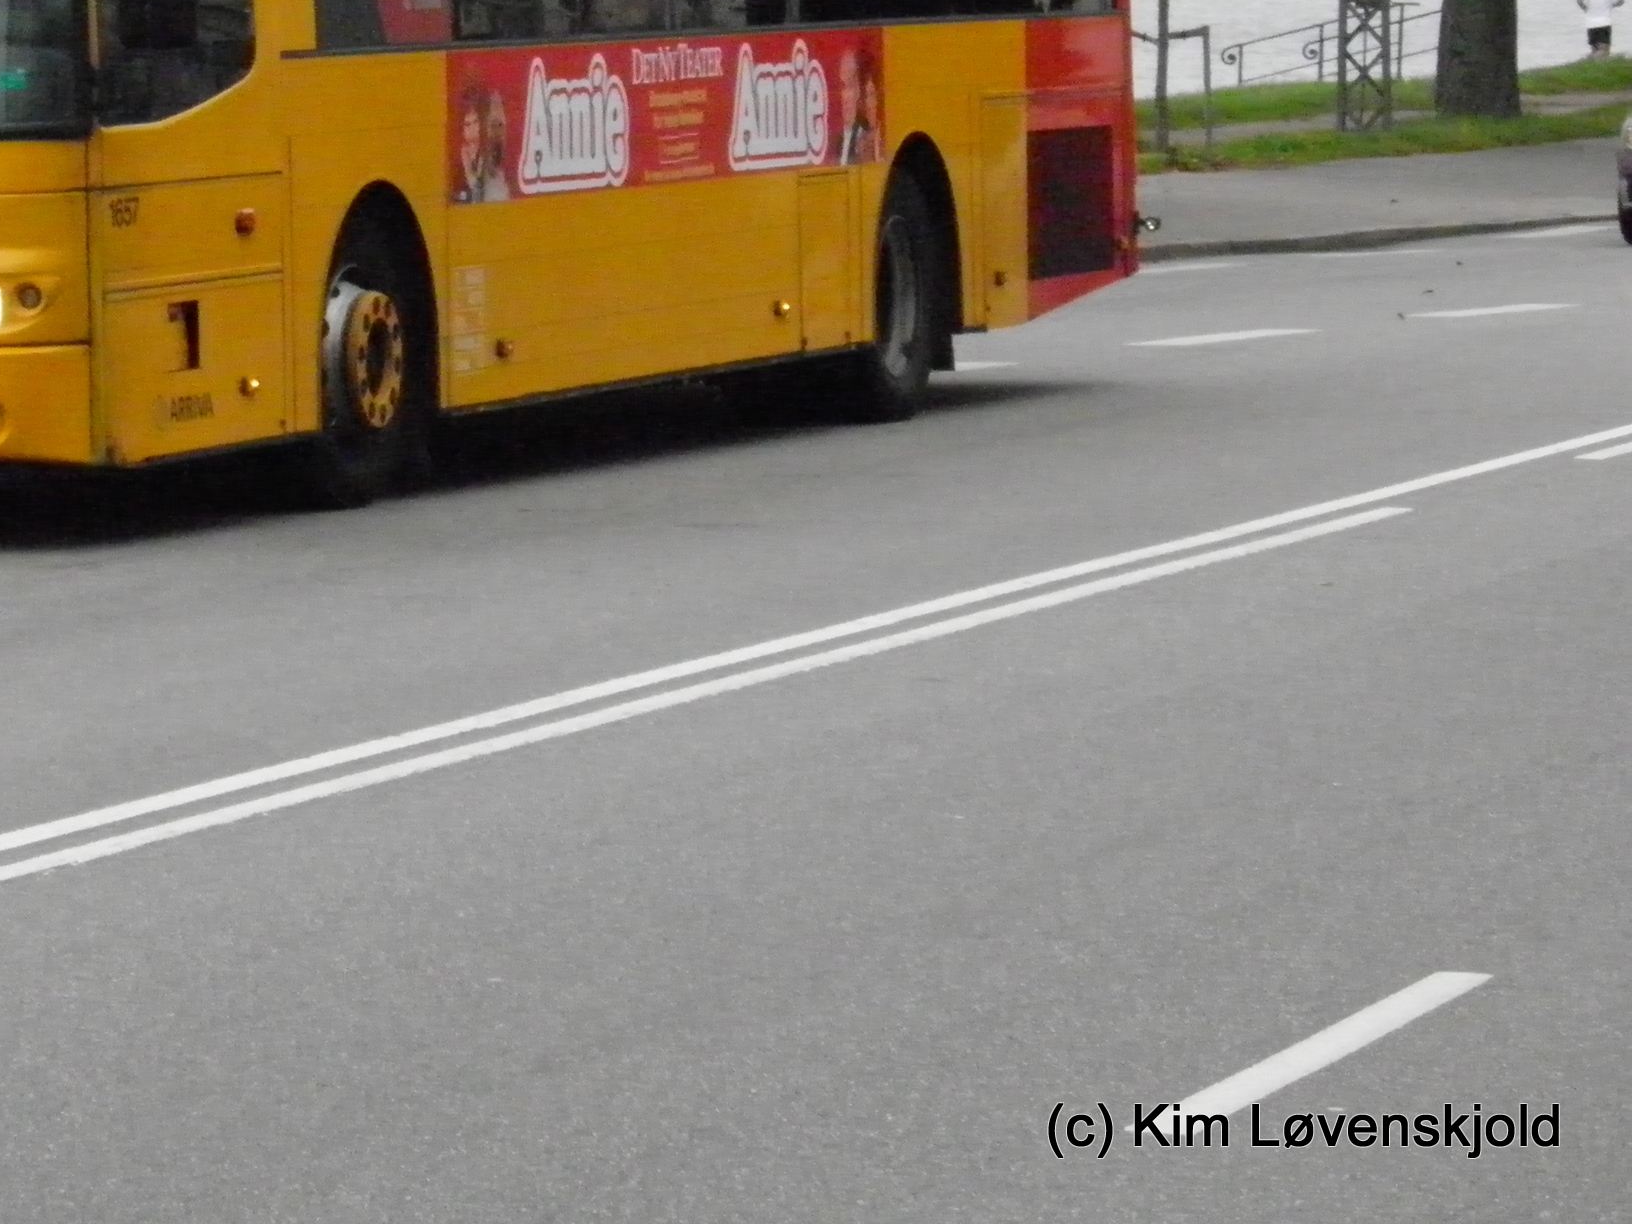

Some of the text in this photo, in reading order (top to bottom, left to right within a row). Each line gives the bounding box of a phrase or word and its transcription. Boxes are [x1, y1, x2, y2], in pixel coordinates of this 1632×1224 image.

[518, 53, 629, 195] Annie
[729, 38, 829, 172] Annie
[109, 196, 139, 228] 1657
